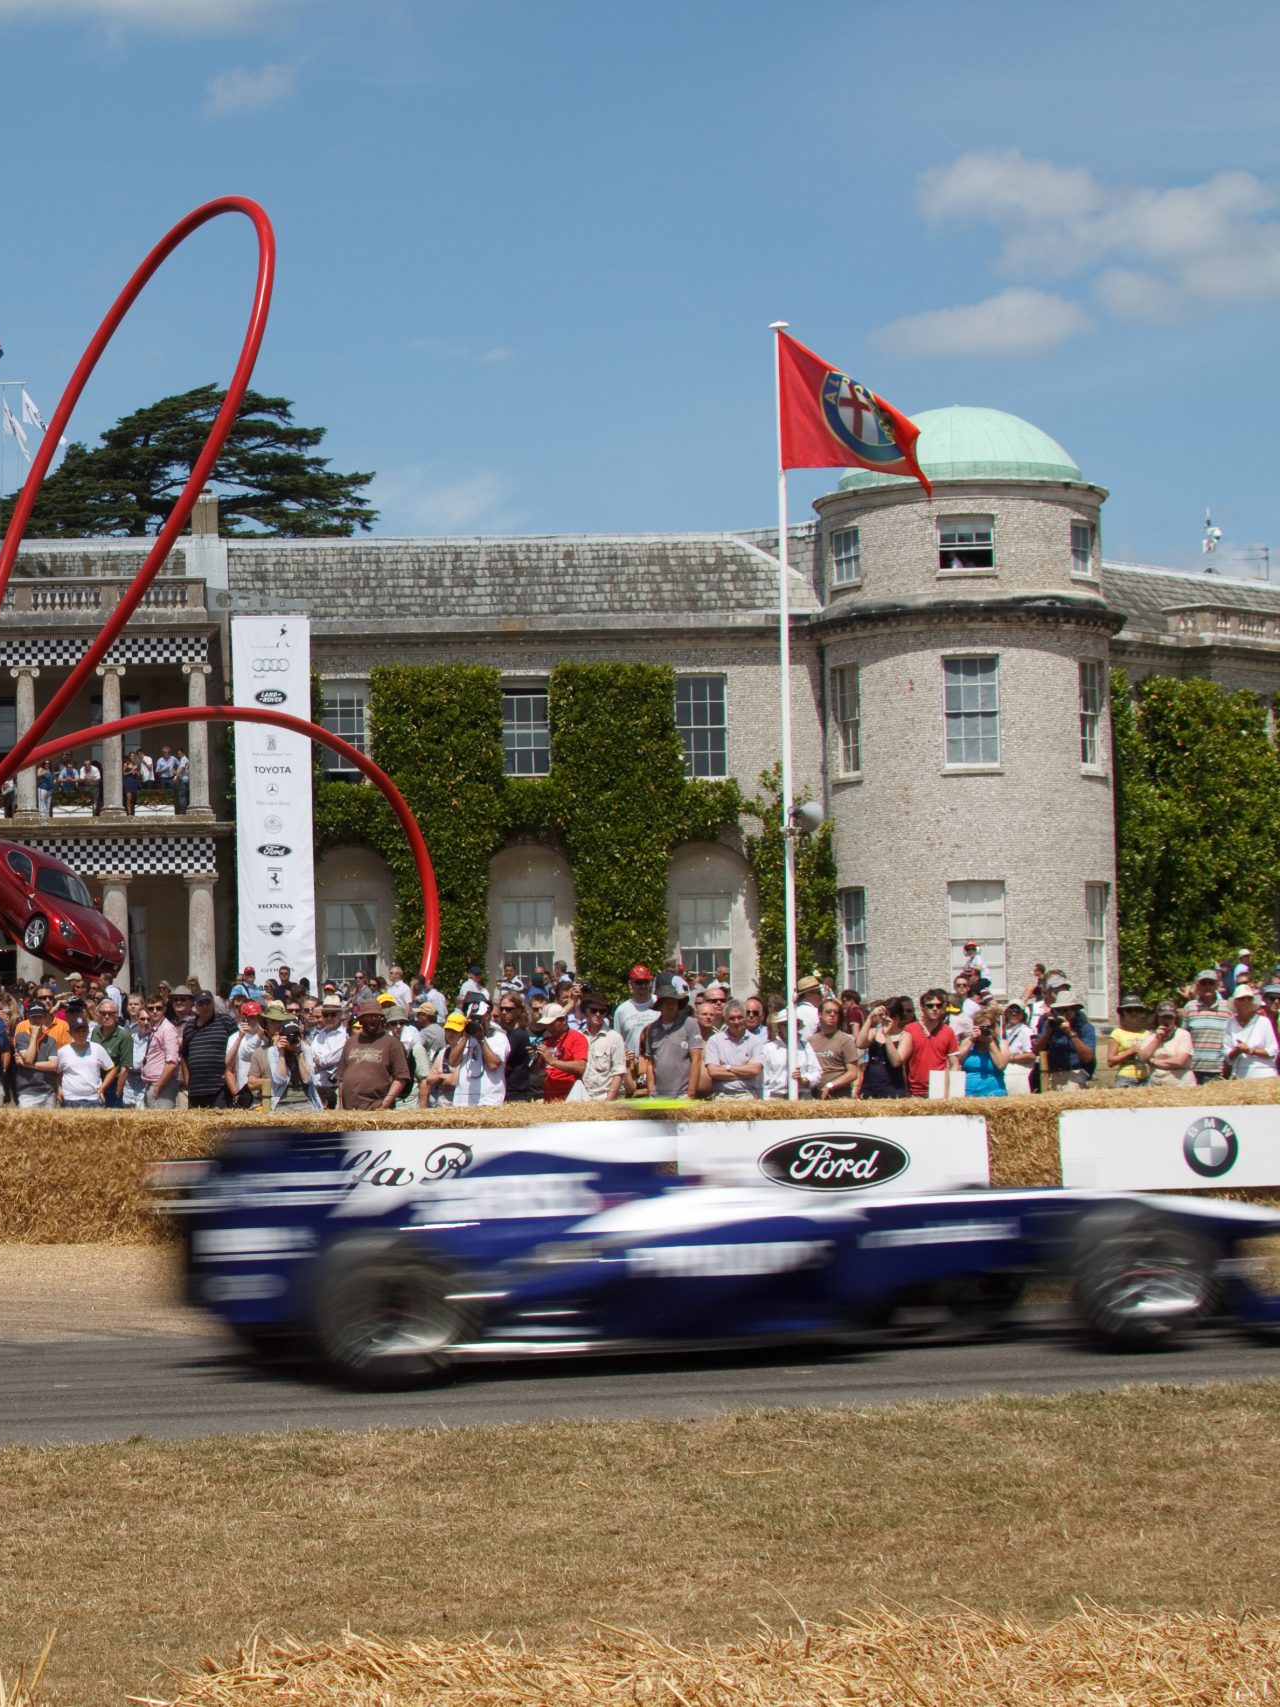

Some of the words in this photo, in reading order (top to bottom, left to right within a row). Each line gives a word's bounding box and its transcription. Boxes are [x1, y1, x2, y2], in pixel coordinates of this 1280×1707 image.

[254, 766, 291, 775] TOYOTA
[263, 845, 286, 856] Ford
[1187, 1118, 1233, 1138] BMW
[342, 1149, 414, 1191] lfa
[789, 1140, 880, 1180] Ford
